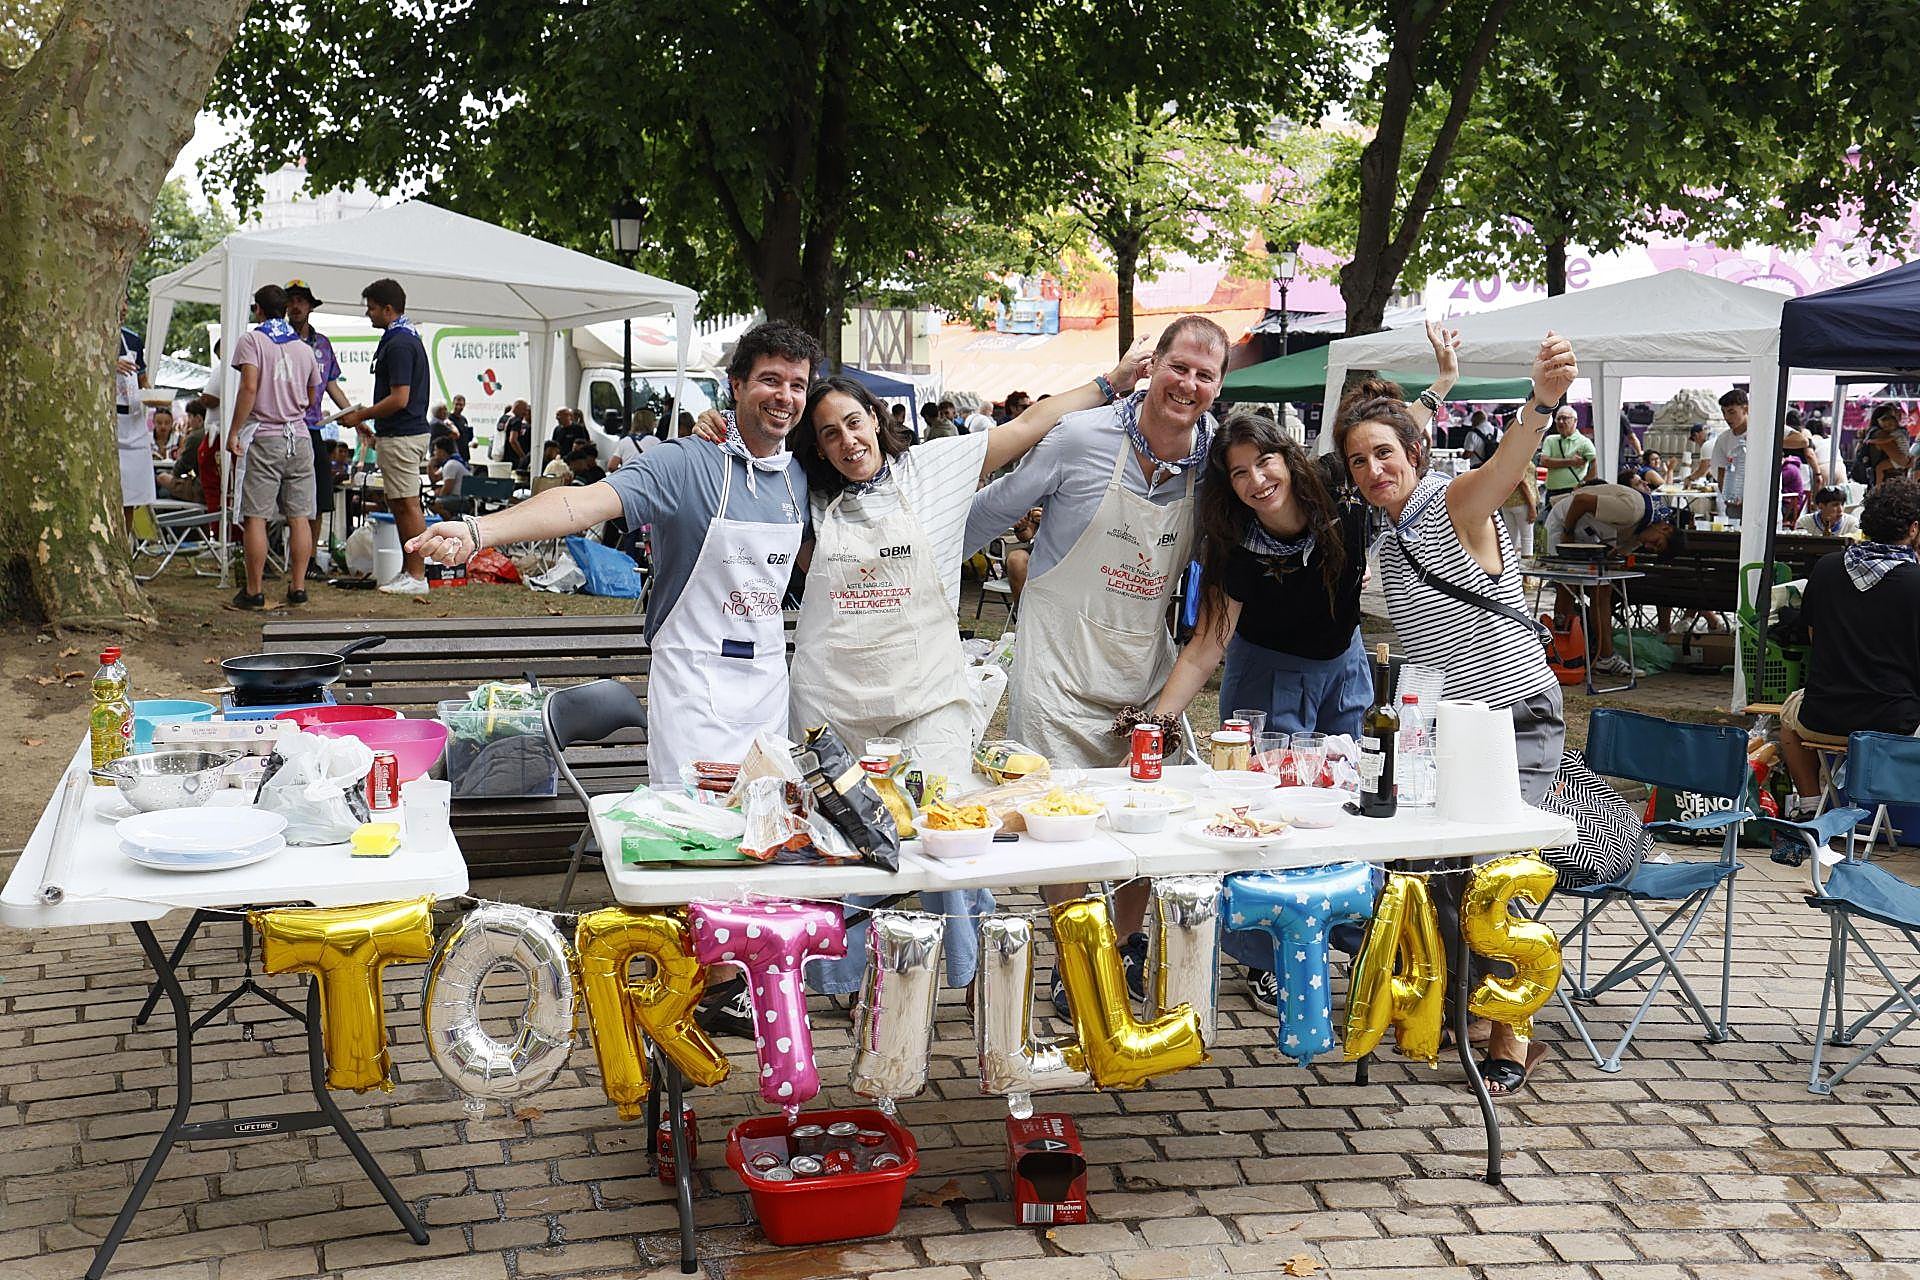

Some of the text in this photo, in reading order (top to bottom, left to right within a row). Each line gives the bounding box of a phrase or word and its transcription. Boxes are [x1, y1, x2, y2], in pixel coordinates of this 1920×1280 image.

[892, 545, 911, 556] BM
[839, 598, 901, 609] LEHIAKETA
[1675, 794, 1733, 812] BUENO
[239, 1122, 273, 1131] LIFETIME
